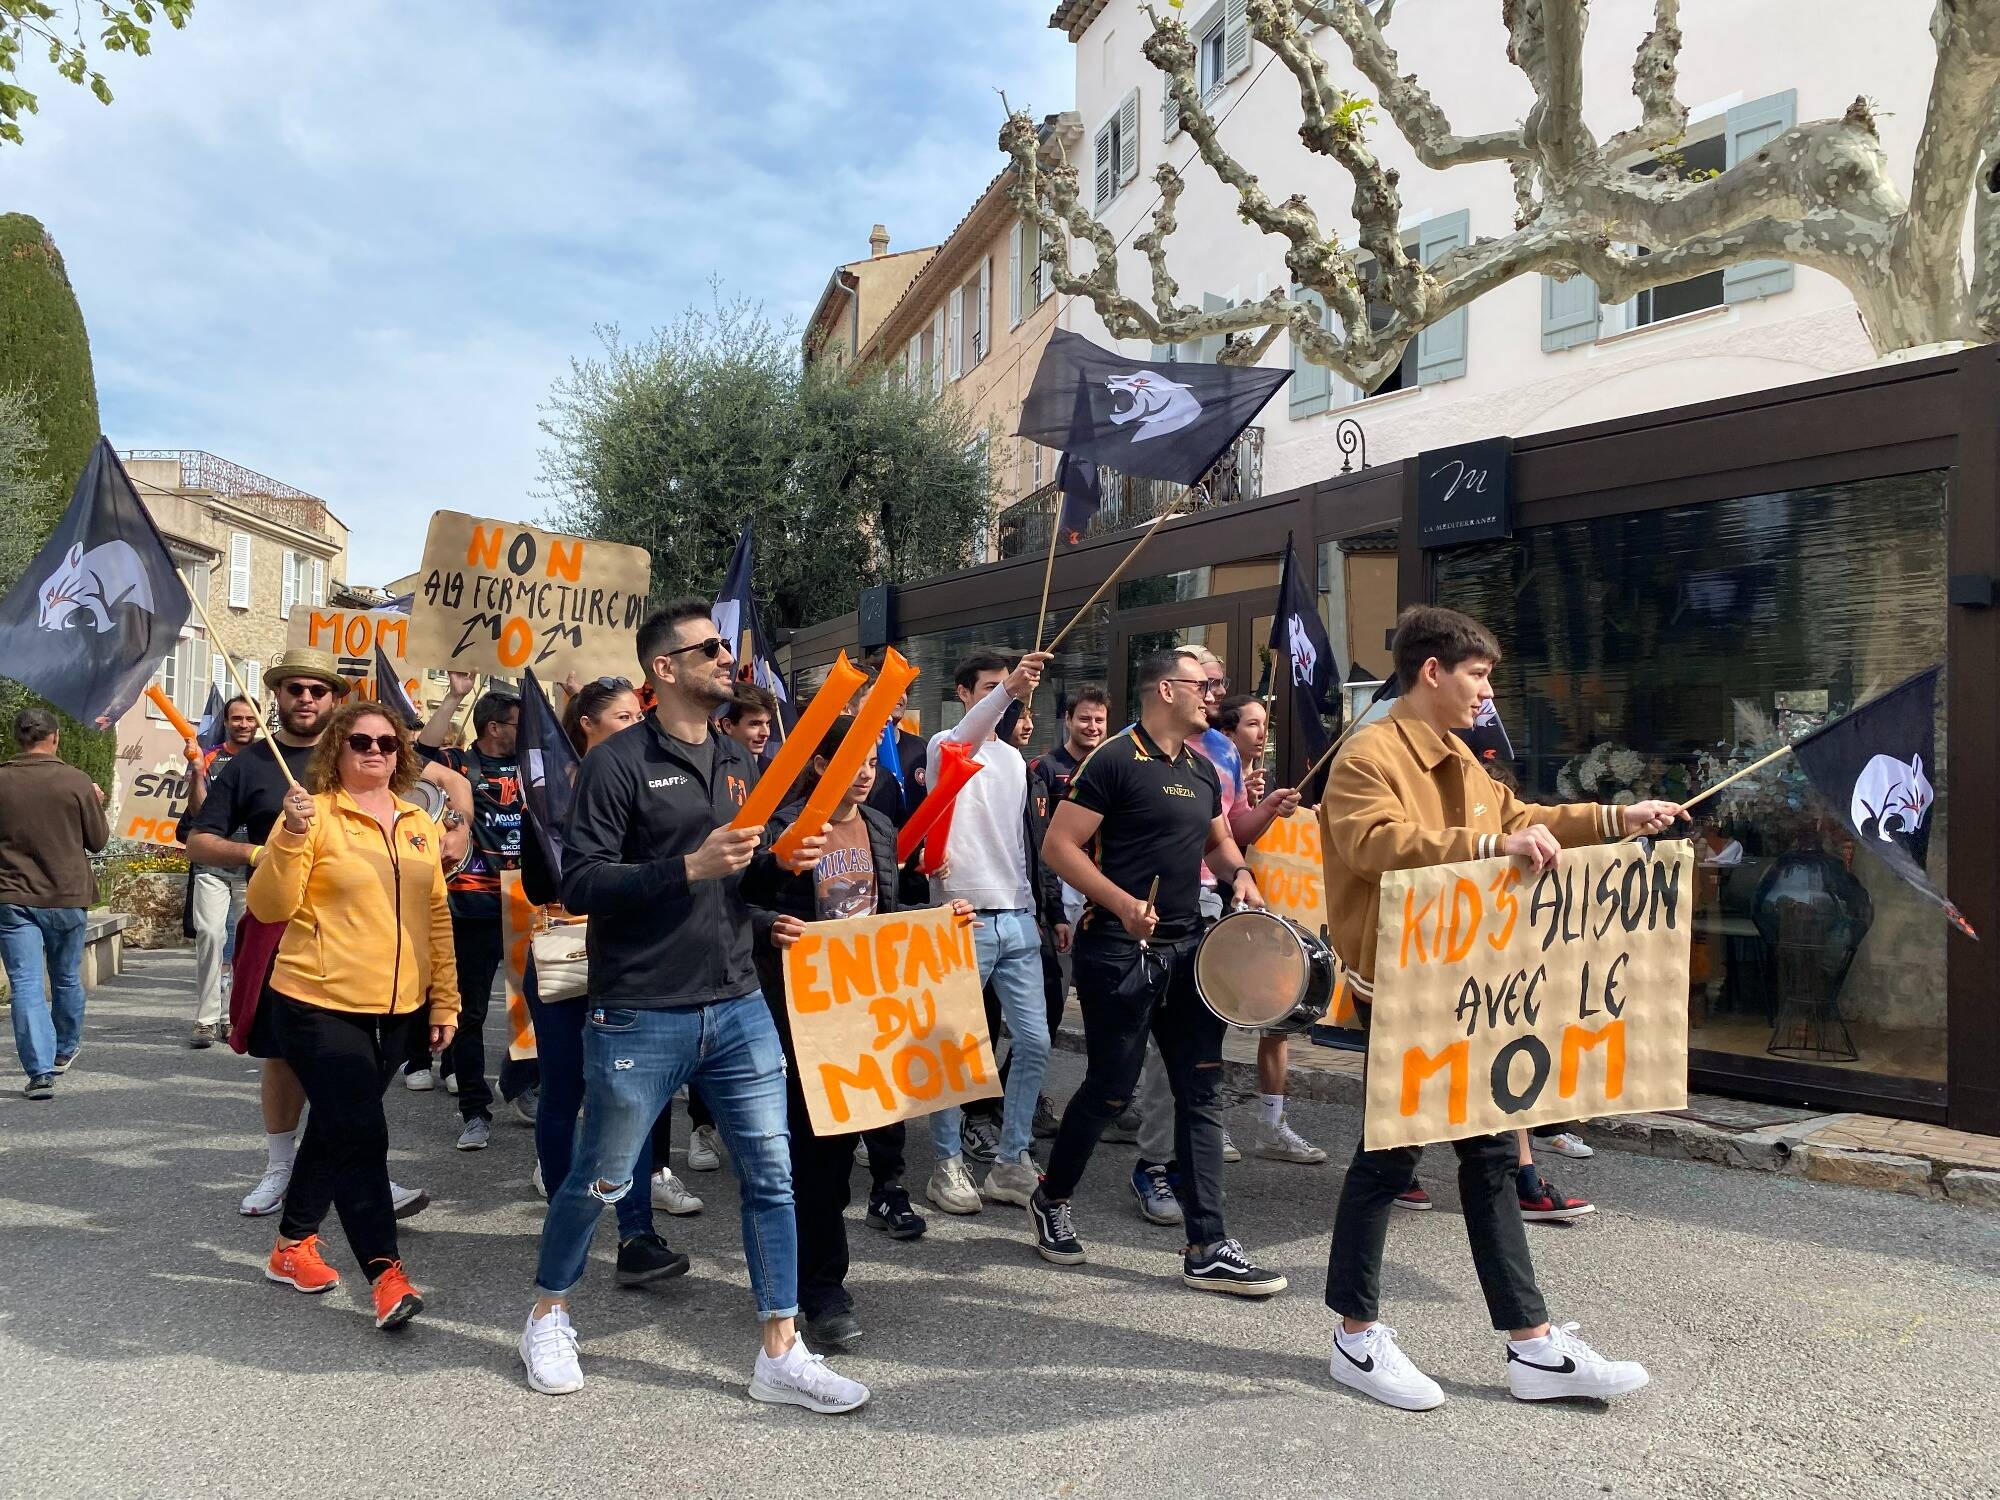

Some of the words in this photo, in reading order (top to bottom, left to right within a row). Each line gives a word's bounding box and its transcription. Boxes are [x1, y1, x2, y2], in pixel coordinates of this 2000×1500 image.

[467, 525, 584, 583] NON
[474, 575, 619, 629] FERMETURE
[308, 611, 408, 659] MOM
[452, 613, 582, 668] MOM
[648, 776, 680, 788] CRAFT
[1162, 786, 1196, 799] VENEZIA
[815, 848, 873, 884] MIKAS
[1399, 864, 1521, 969] KID'S
[1530, 857, 1681, 952] ALISON
[789, 914, 974, 1013] ENFANT
[867, 988, 937, 1051] DU
[1454, 963, 1547, 1036] AVEC
[1578, 952, 1630, 1019] LE
[818, 1033, 988, 1122] MOM
[1400, 1019, 1626, 1125] MOM
